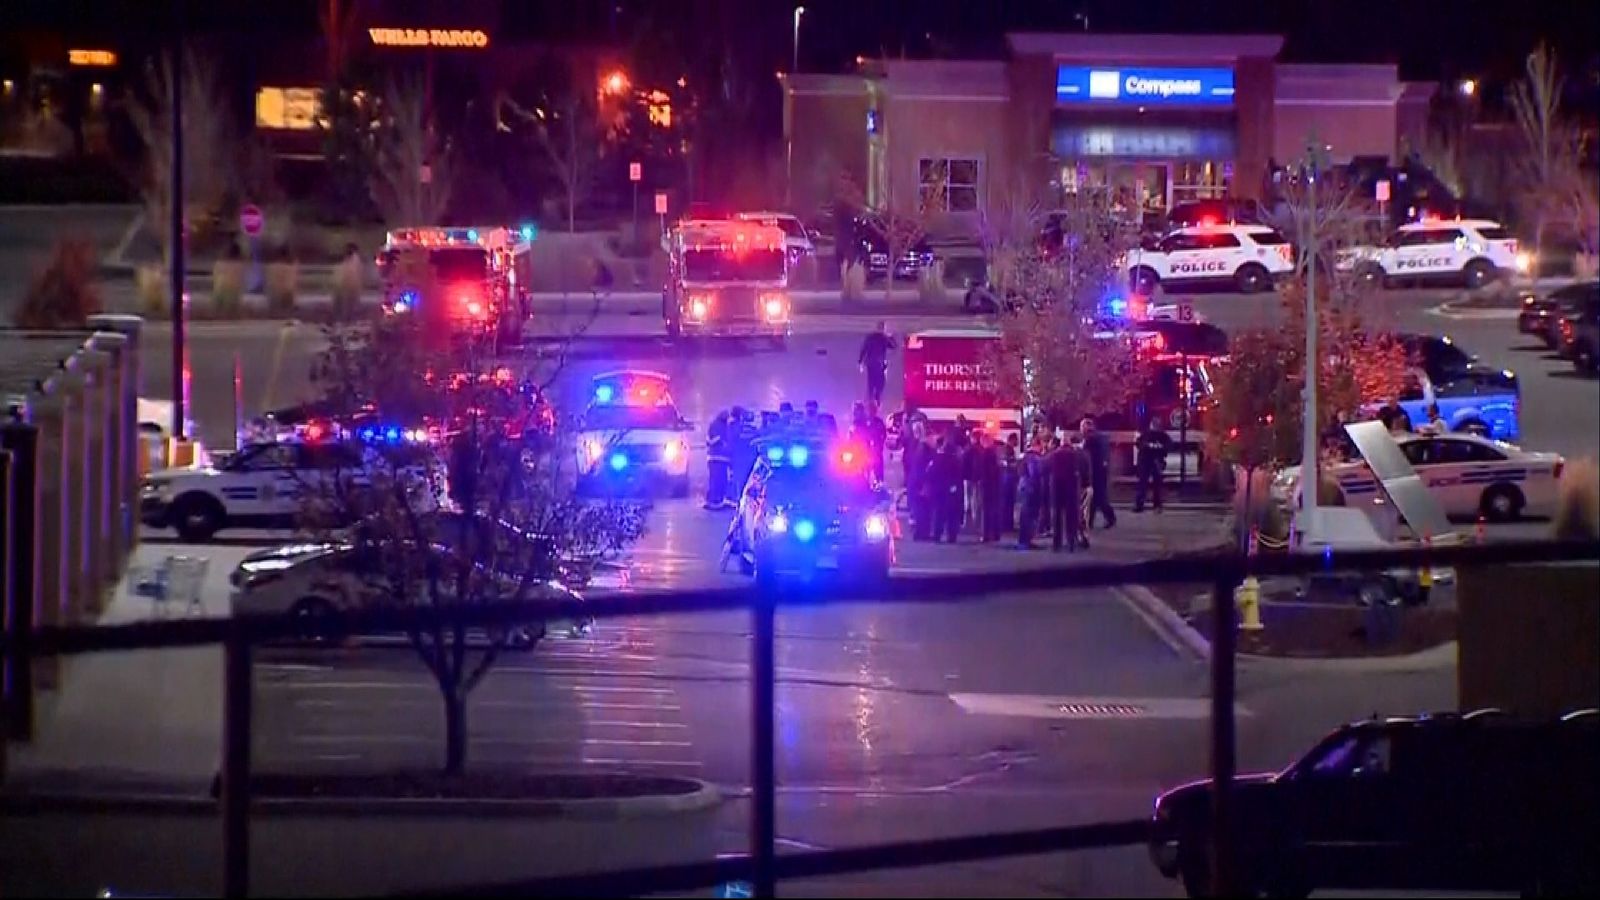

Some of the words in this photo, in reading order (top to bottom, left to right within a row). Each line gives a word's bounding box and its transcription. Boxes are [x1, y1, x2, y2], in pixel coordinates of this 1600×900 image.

[1125, 76, 1201, 98] Compass
[1169, 260, 1228, 274] POLICE
[1396, 257, 1453, 269] POLICE
[1178, 304, 1194, 322] 13
[923, 362, 994, 376] THORNT
